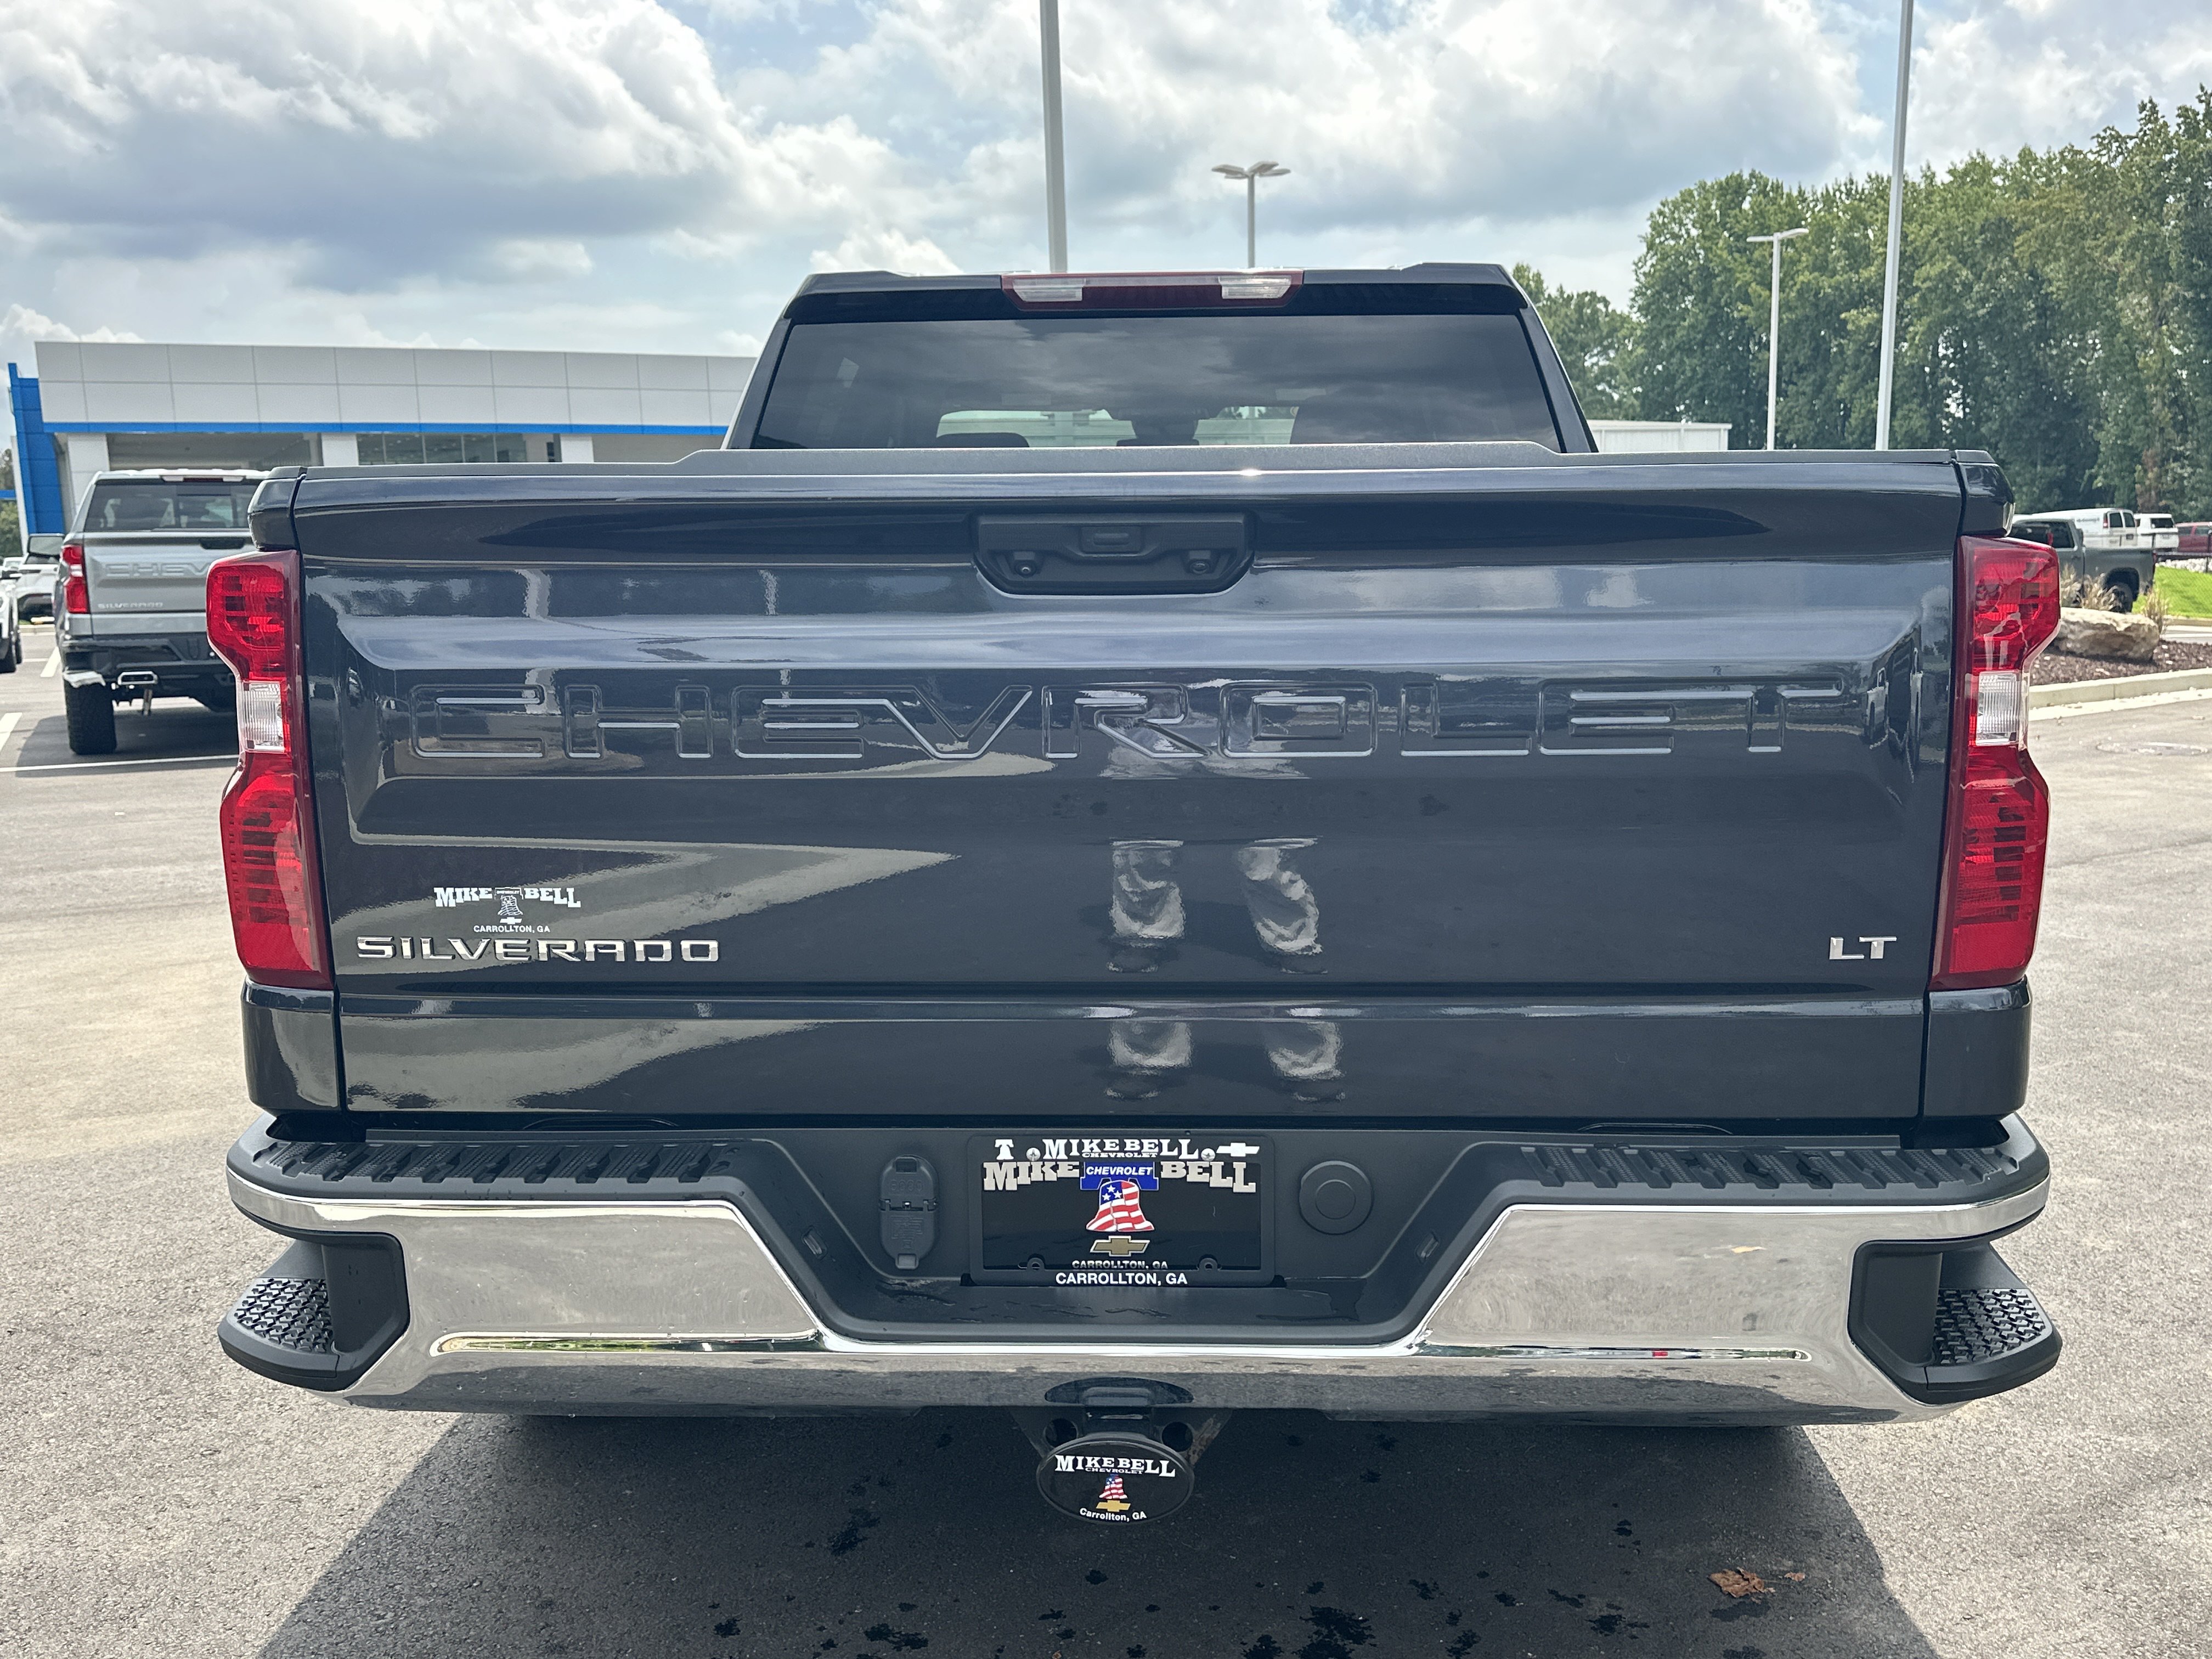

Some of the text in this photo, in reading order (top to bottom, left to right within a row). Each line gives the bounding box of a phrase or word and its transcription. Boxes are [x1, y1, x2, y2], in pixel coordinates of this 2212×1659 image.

[408, 675, 1844, 760] CHEVROLET
[433, 887, 581, 907] MIKE BELL
[473, 925, 535, 933] CARROLLTON,
[357, 936, 719, 962] SILVERADO
[1829, 936, 1897, 960] LT
[1042, 1139, 1199, 1160] MIKE BELL
[983, 1161, 1256, 1193] MIKE BELL
[1086, 1166, 1153, 1175] CHEVROLET
[1152, 1261, 1169, 1269] GA
[1056, 1272, 1188, 1286] CARROLLTON, GA
[1055, 1454, 1176, 1477] MIKE BELL
[1079, 1508, 1147, 1522] Carrollton, GA
